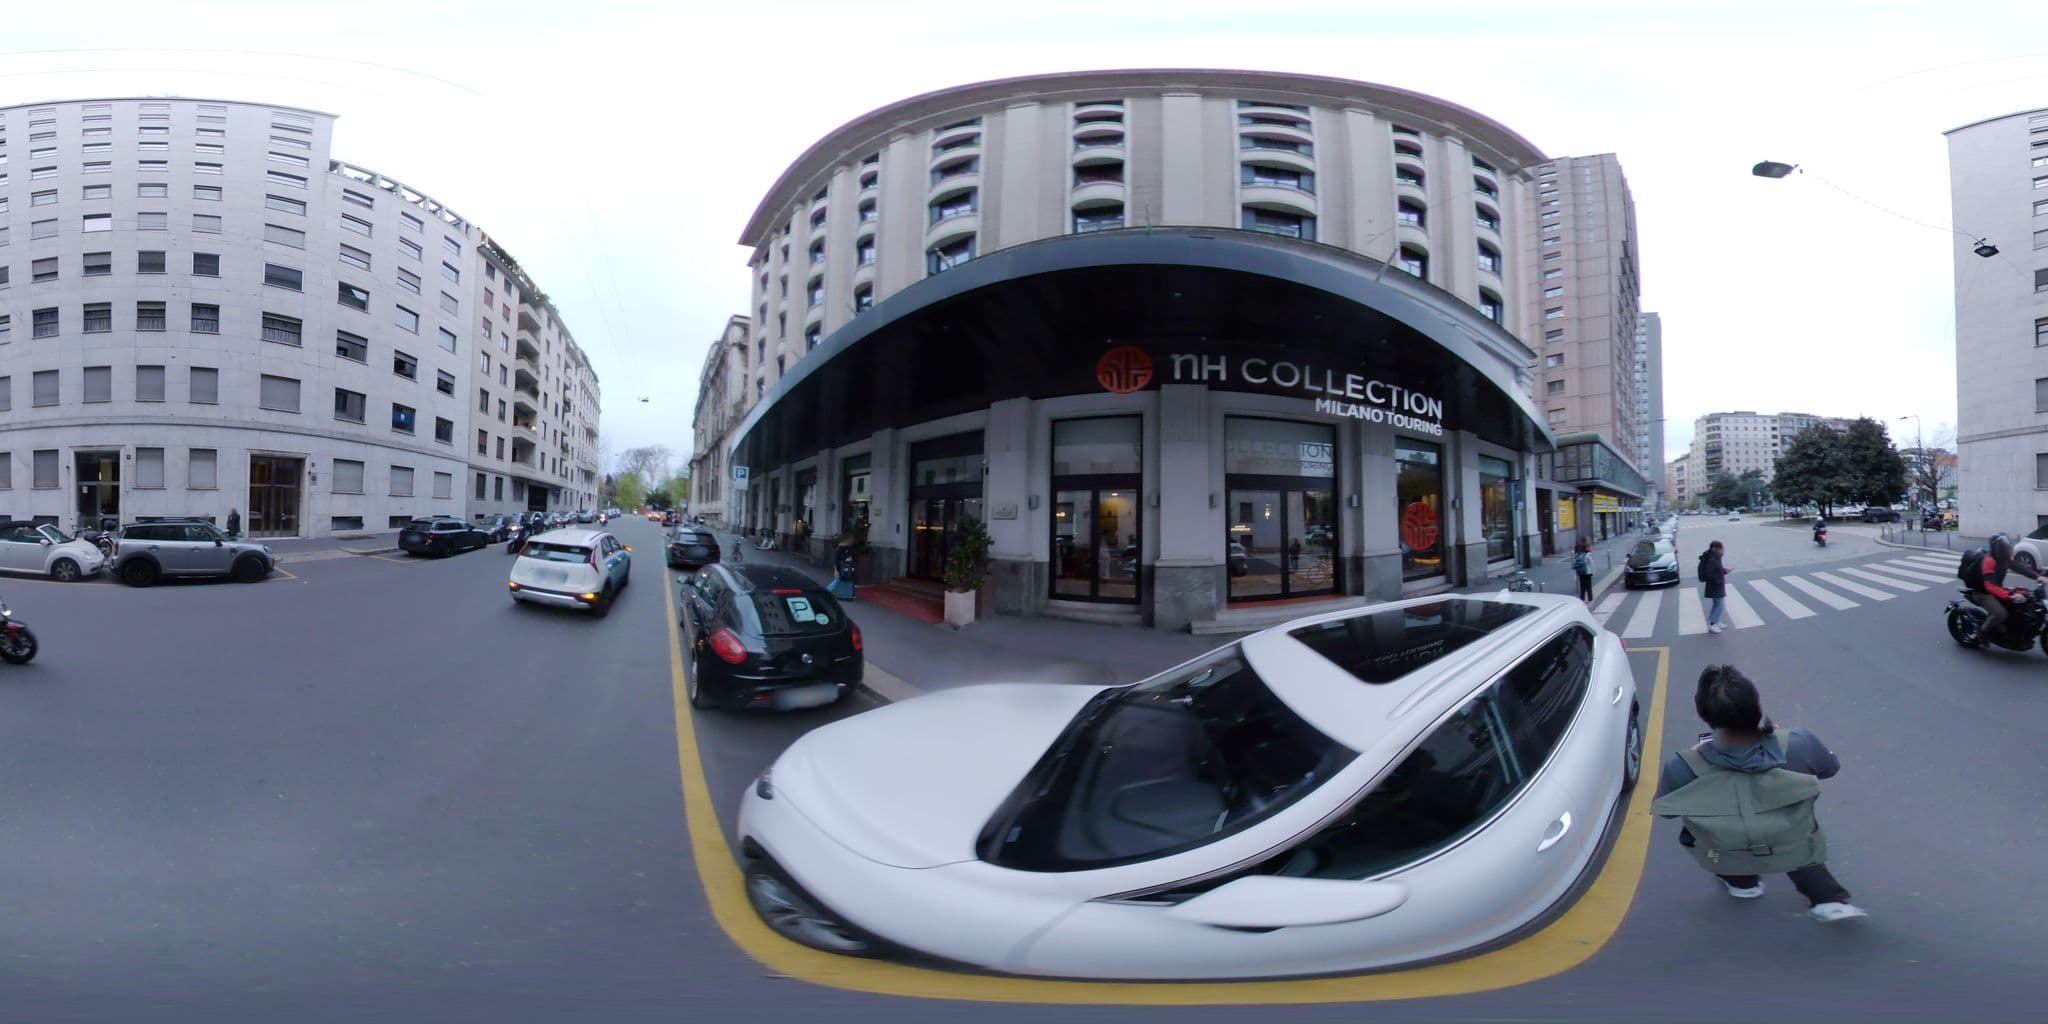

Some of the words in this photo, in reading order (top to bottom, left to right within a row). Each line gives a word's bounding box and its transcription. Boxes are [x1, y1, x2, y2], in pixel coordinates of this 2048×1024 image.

[1241, 358, 1443, 420] COLLECTION
[1315, 398, 1384, 423] MILANO
[1385, 411, 1442, 436] TOURING
